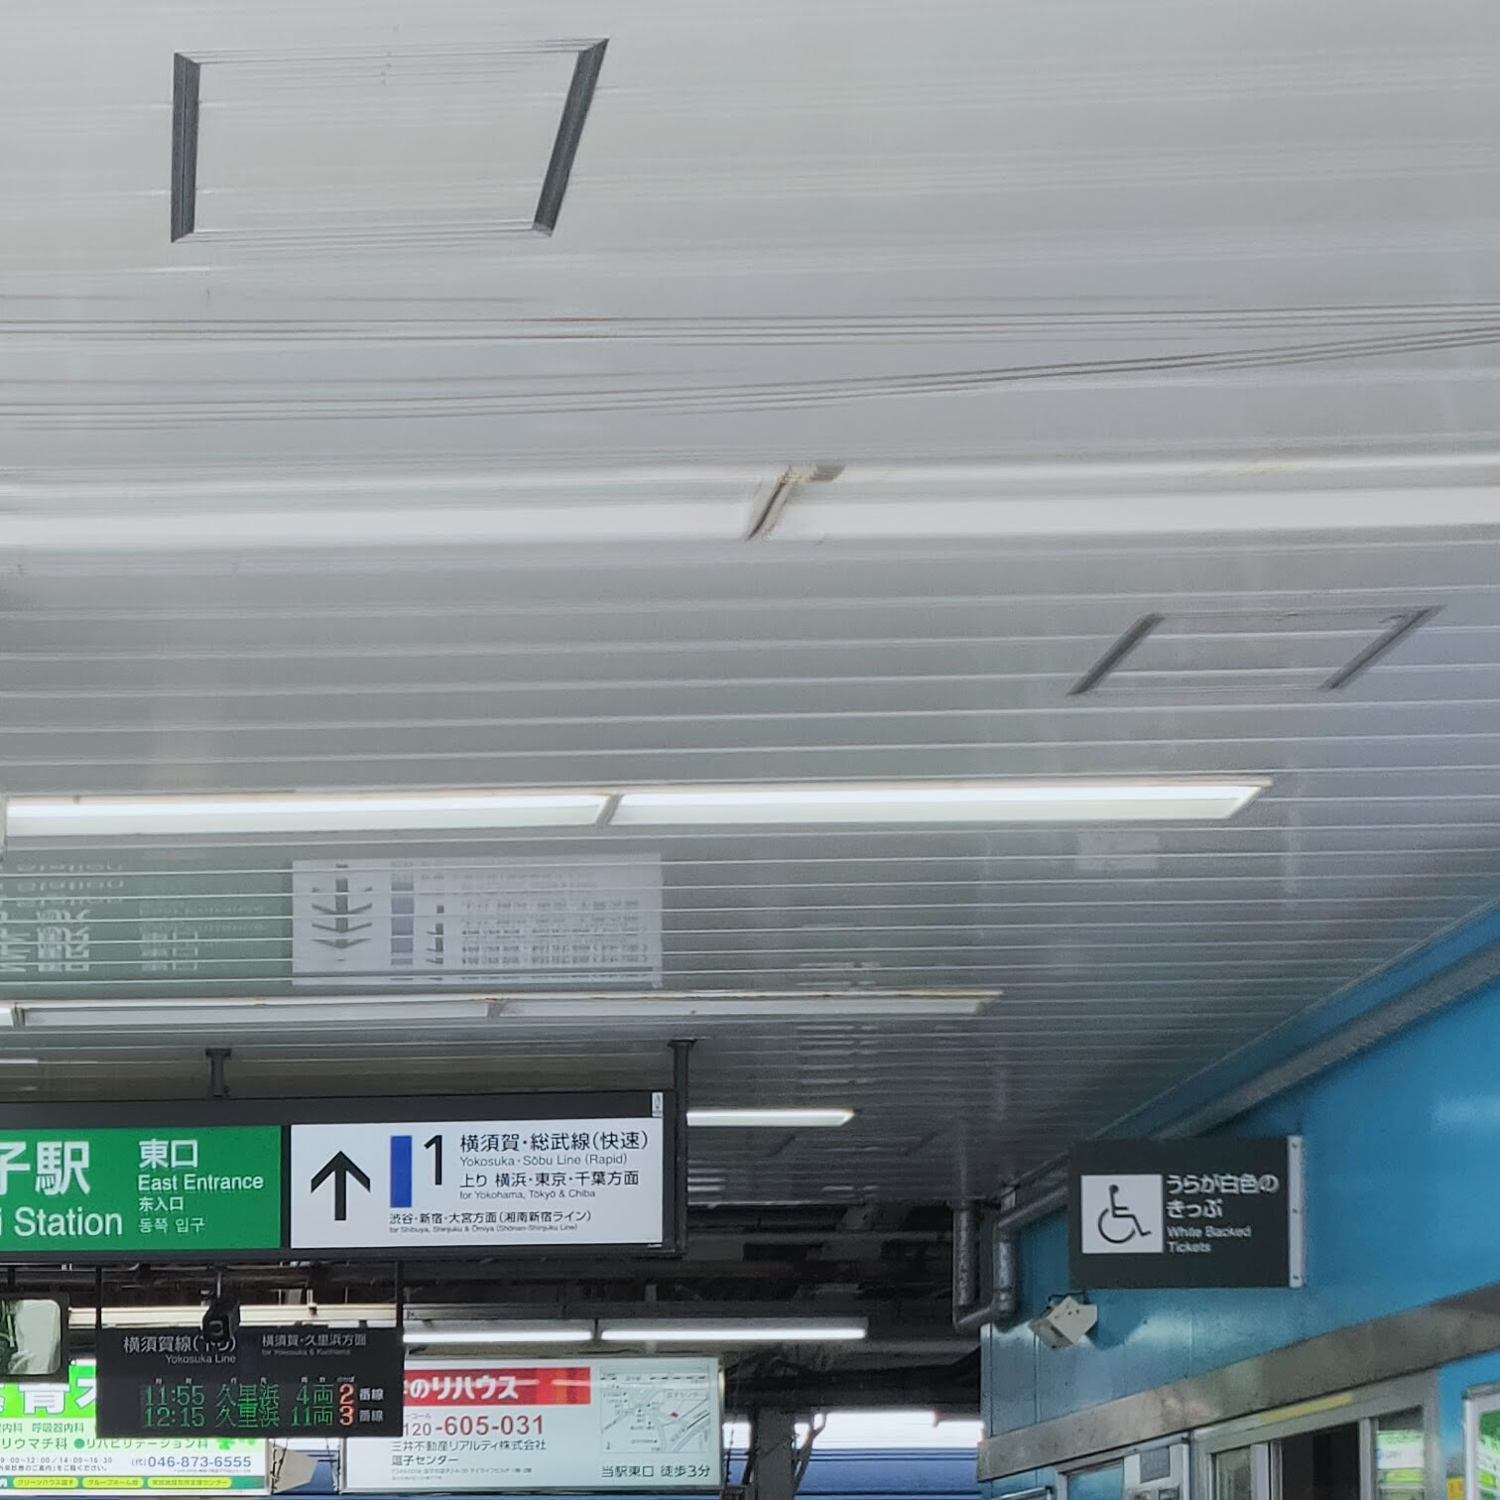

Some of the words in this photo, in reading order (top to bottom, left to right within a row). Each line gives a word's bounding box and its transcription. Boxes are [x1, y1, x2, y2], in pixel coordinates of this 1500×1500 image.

[460, 1131, 648, 1153] 横須賀・総武線(快速)
[138, 1138, 198, 1168] 東口
[423, 1135, 443, 1186] 1
[460, 1156, 515, 1167] Yokosuka
[557, 1155, 581, 1165] Line
[585, 1153, 628, 1166] (Rapid)
[138, 1175, 178, 1191] East
[184, 1174, 264, 1191] Entrance
[460, 1174, 488, 1188] 上り
[495, 1170, 639, 1188] 横浜・東京・千葉方面
[1166, 1174, 1279, 1195] うらが白色の
[460, 1191, 473, 1200] for
[559, 1190, 566, 1198] &
[568, 1189, 596, 1198] Chiba
[138, 1196, 184, 1213] 东入口
[1166, 1199, 1223, 1218] きっぷ
[14, 1207, 123, 1237] Station
[138, 1217, 168, 1234] 동쪽
[175, 1217, 206, 1234] 입구
[1167, 1226, 1202, 1238] White
[1205, 1226, 1251, 1238] Backed
[1167, 1241, 1212, 1253] Tickets
[165, 1354, 212, 1365] Yokosuka
[215, 1354, 237, 1364] Line
[144, 1384, 205, 1406] 11:55
[215, 1384, 280, 1406] 久里浜
[296, 1384, 334, 1406] 4両
[339, 1384, 354, 1405] 2
[359, 1388, 385, 1401] 番線
[403, 1375, 519, 1400] のリハウス
[144, 1407, 205, 1428] 12:15
[215, 1405, 280, 1428] 久里浜
[291, 1406, 334, 1427] 11両
[339, 1405, 354, 1426] 3
[359, 1410, 385, 1423] 番線
[391, 1440, 547, 1452] 三井不動産リアルティ株式会社
[148, 1456, 252, 1468] 046-873-6555
[601, 1465, 654, 1477] 当駅東口
[660, 1465, 710, 1478] 徒歩3分
